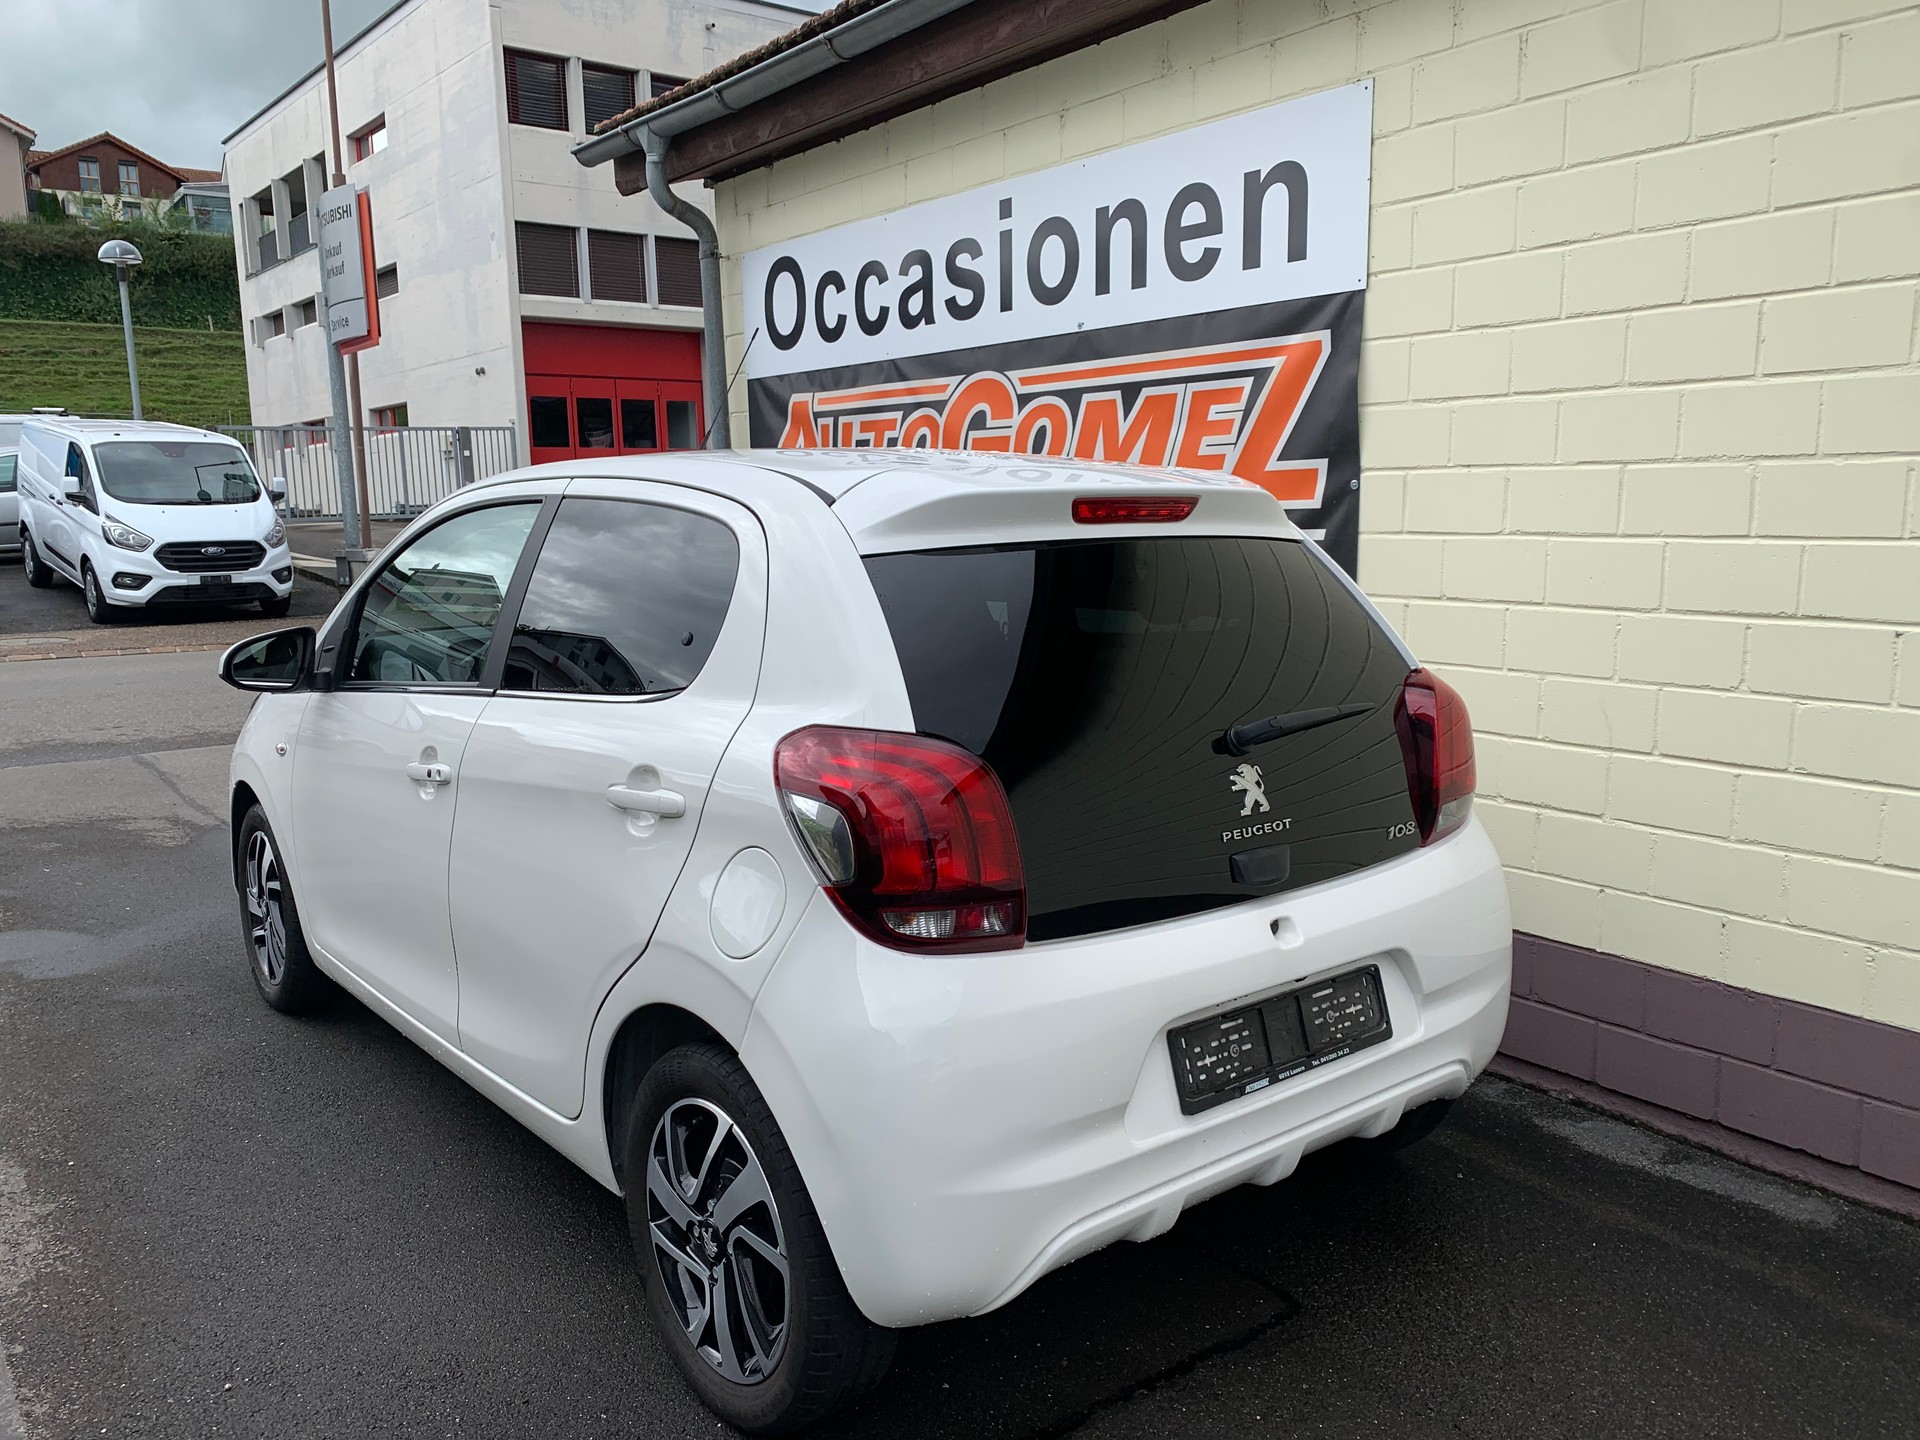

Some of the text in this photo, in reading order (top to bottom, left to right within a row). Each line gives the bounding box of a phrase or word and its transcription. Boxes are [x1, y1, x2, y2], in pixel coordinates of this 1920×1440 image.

[763, 159, 1309, 351] Occasionen
[1222, 818, 1292, 843] PEUGEOT
[1386, 821, 1416, 841] 108
